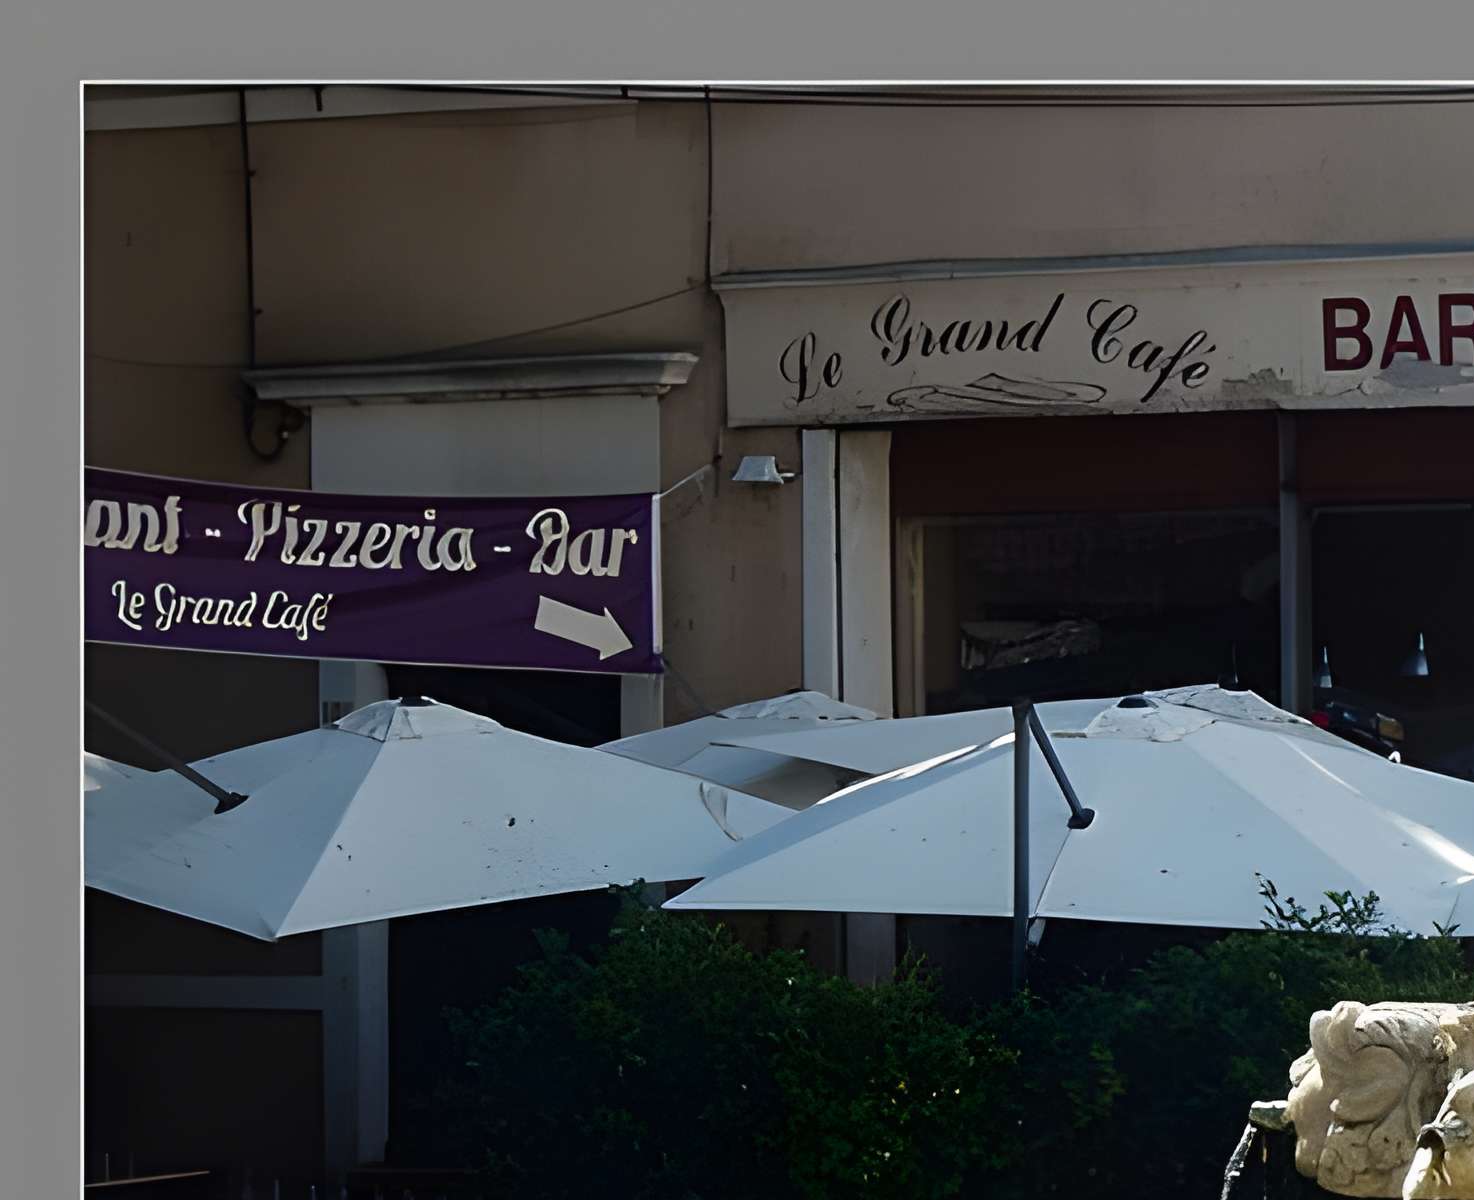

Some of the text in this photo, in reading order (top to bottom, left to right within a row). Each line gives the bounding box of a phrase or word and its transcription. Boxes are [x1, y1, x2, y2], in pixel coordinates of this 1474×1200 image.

[780, 293, 1217, 405] Le Grand Café
[237, 500, 477, 571] Pizzeria
[525, 508, 638, 577] Bar
[111, 580, 334, 640] Le Grand Café
